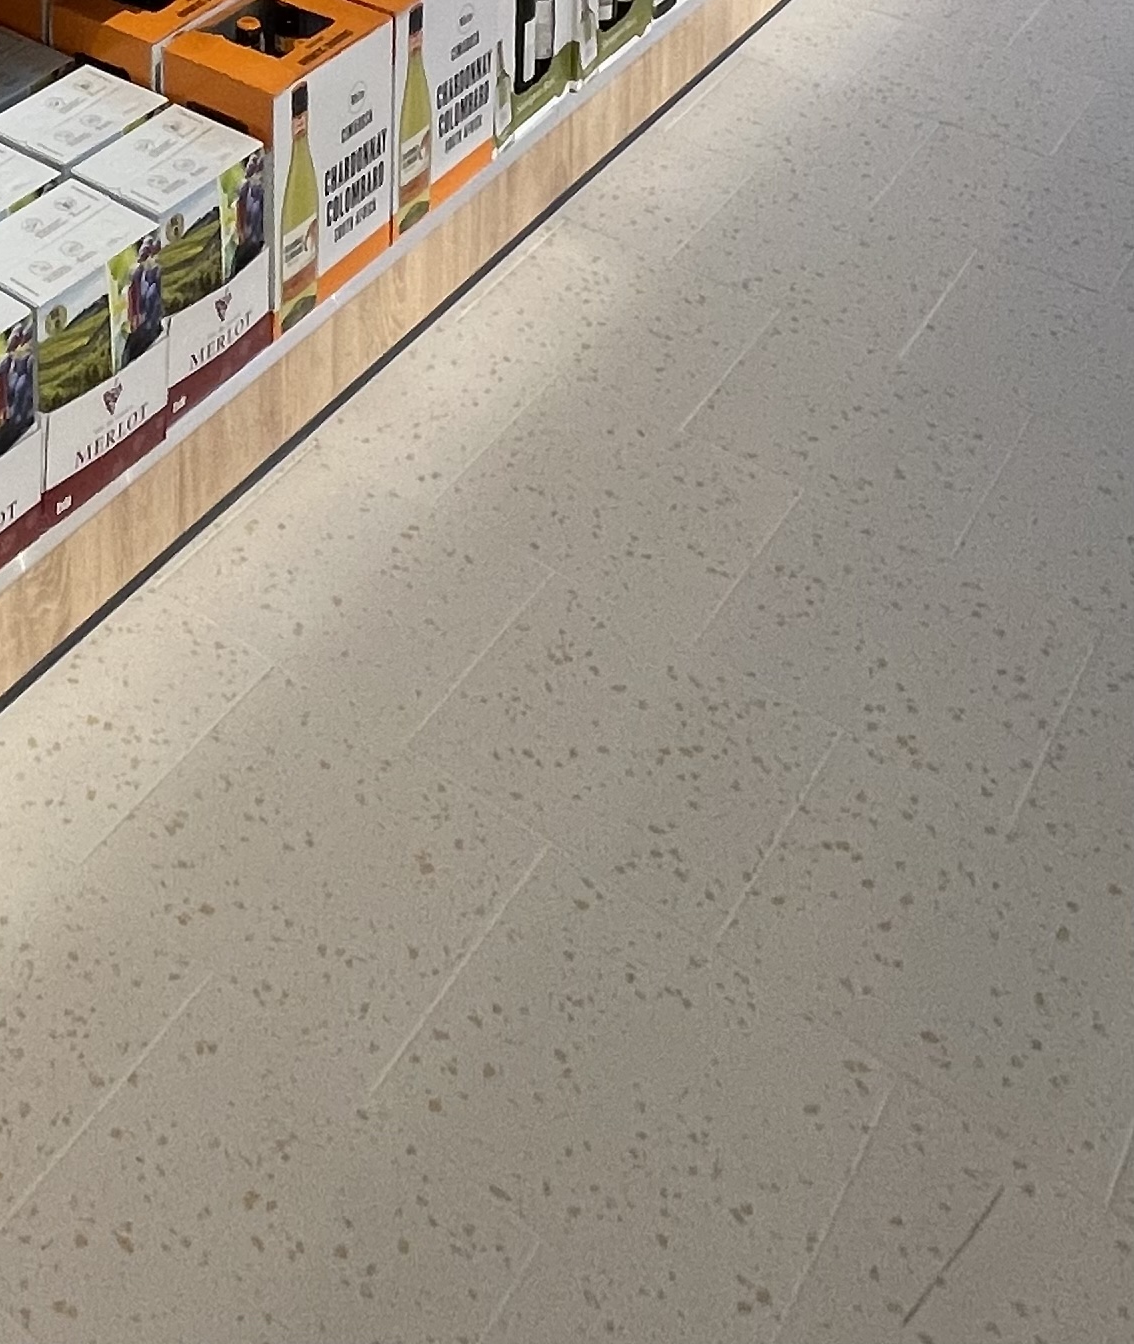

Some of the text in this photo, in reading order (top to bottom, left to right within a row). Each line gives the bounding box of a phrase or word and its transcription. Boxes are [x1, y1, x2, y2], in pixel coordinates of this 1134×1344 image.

[436, 49, 492, 110] CHARDONNAY
[438, 80, 490, 138] COLOMBARD
[325, 128, 387, 197] CHARDONNAY
[326, 161, 385, 227] COLOMBARD
[190, 309, 253, 370] MERLOT
[74, 402, 149, 469] MERLOT
